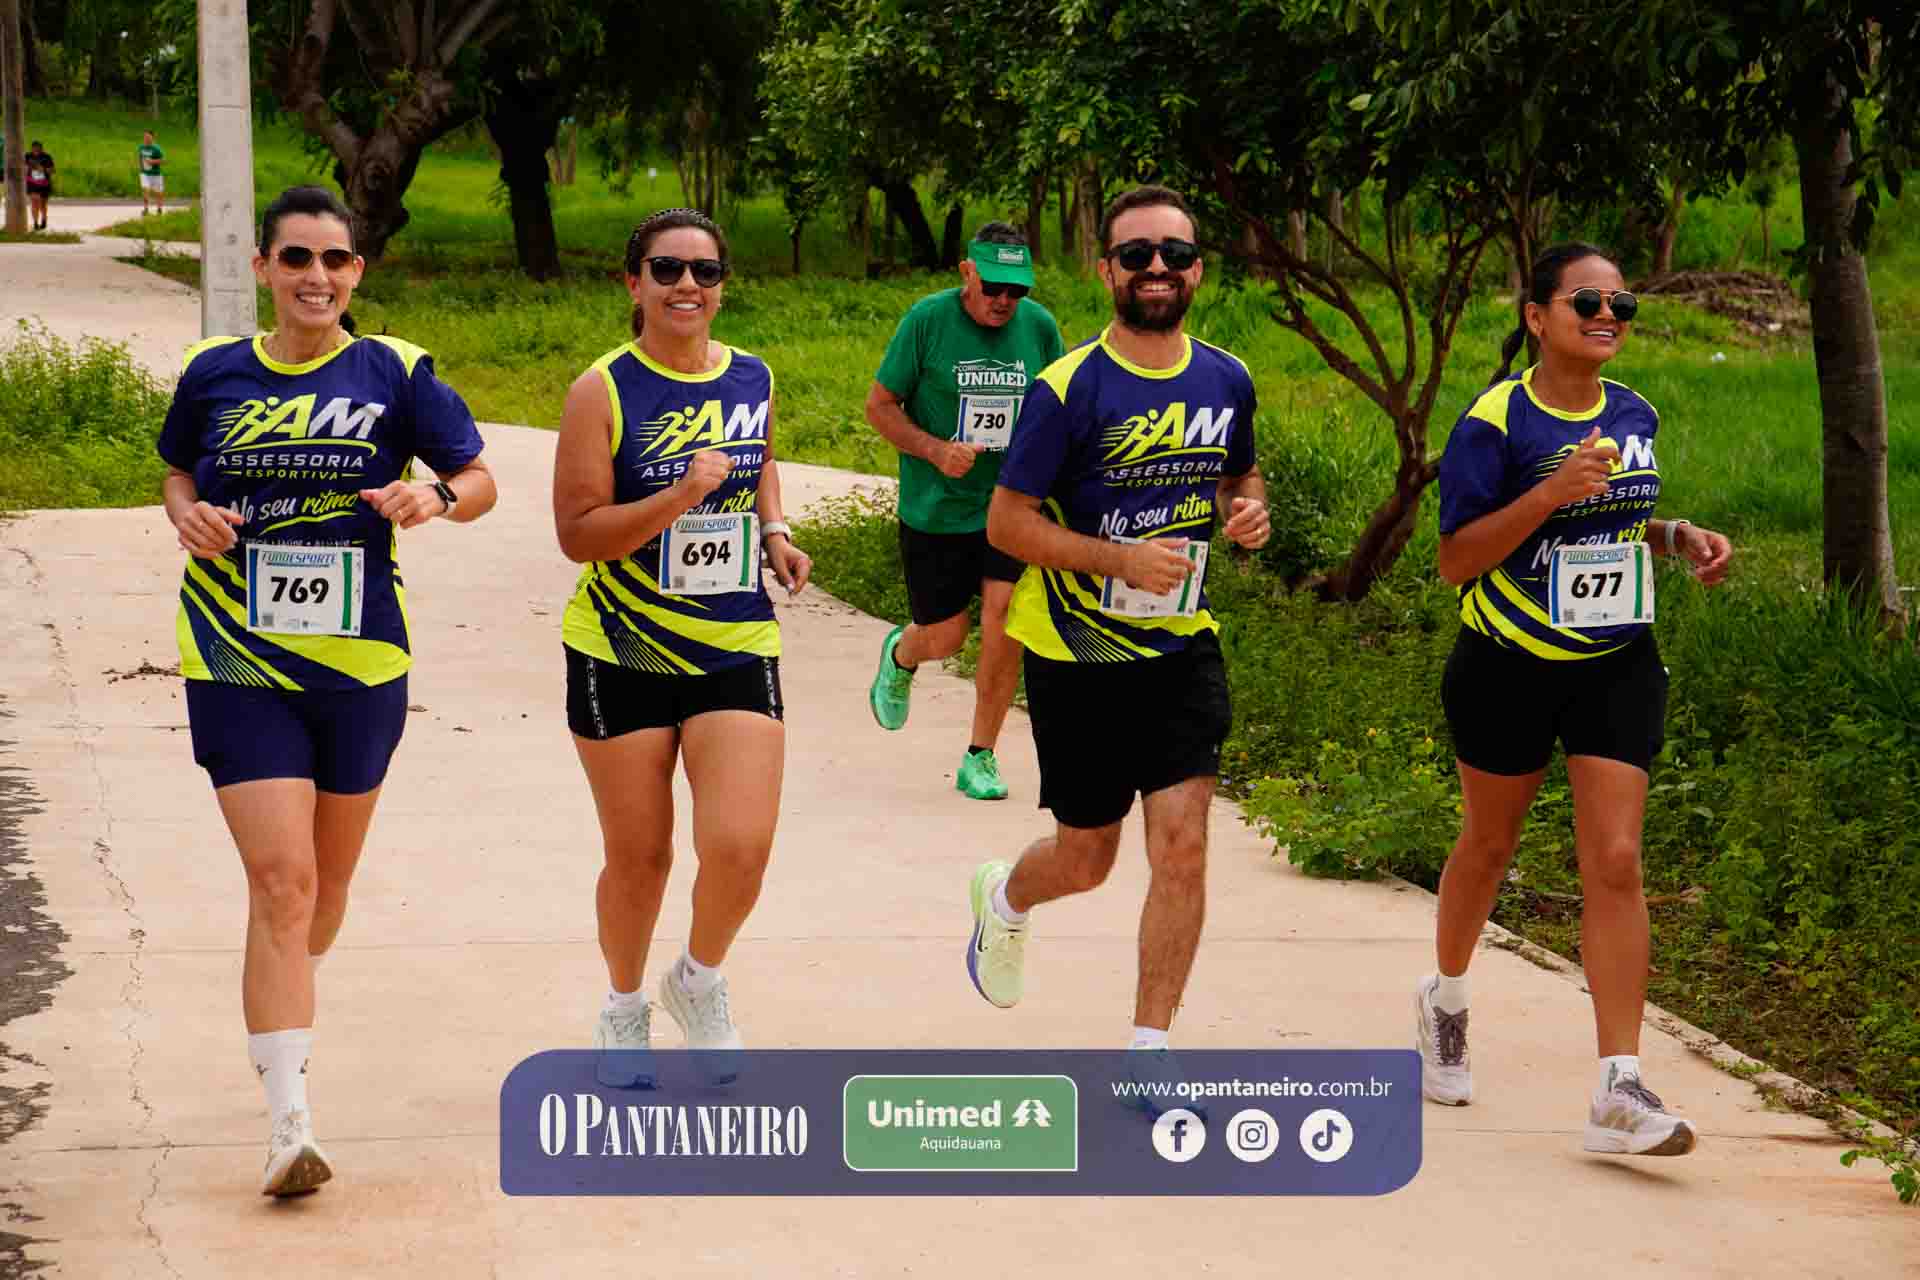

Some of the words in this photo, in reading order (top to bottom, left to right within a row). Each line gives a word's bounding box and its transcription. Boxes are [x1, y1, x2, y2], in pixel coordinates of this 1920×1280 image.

[957, 372, 1027, 387] UNIMED
[973, 413, 1006, 429] 730
[215, 454, 364, 468] ASSESSORIA
[1103, 461, 1222, 480] ASSESSORIA
[246, 469, 338, 481] ESPORTIVA
[258, 497, 297, 520] seu
[301, 489, 359, 514] ritmo
[1571, 500, 1650, 518] ESPORTIVA
[1098, 508, 1129, 538] No
[1132, 507, 1168, 530] seu
[1172, 492, 1213, 522] ritm
[682, 540, 731, 567] 694
[271, 576, 329, 604] 769
[1571, 571, 1622, 598] 677
